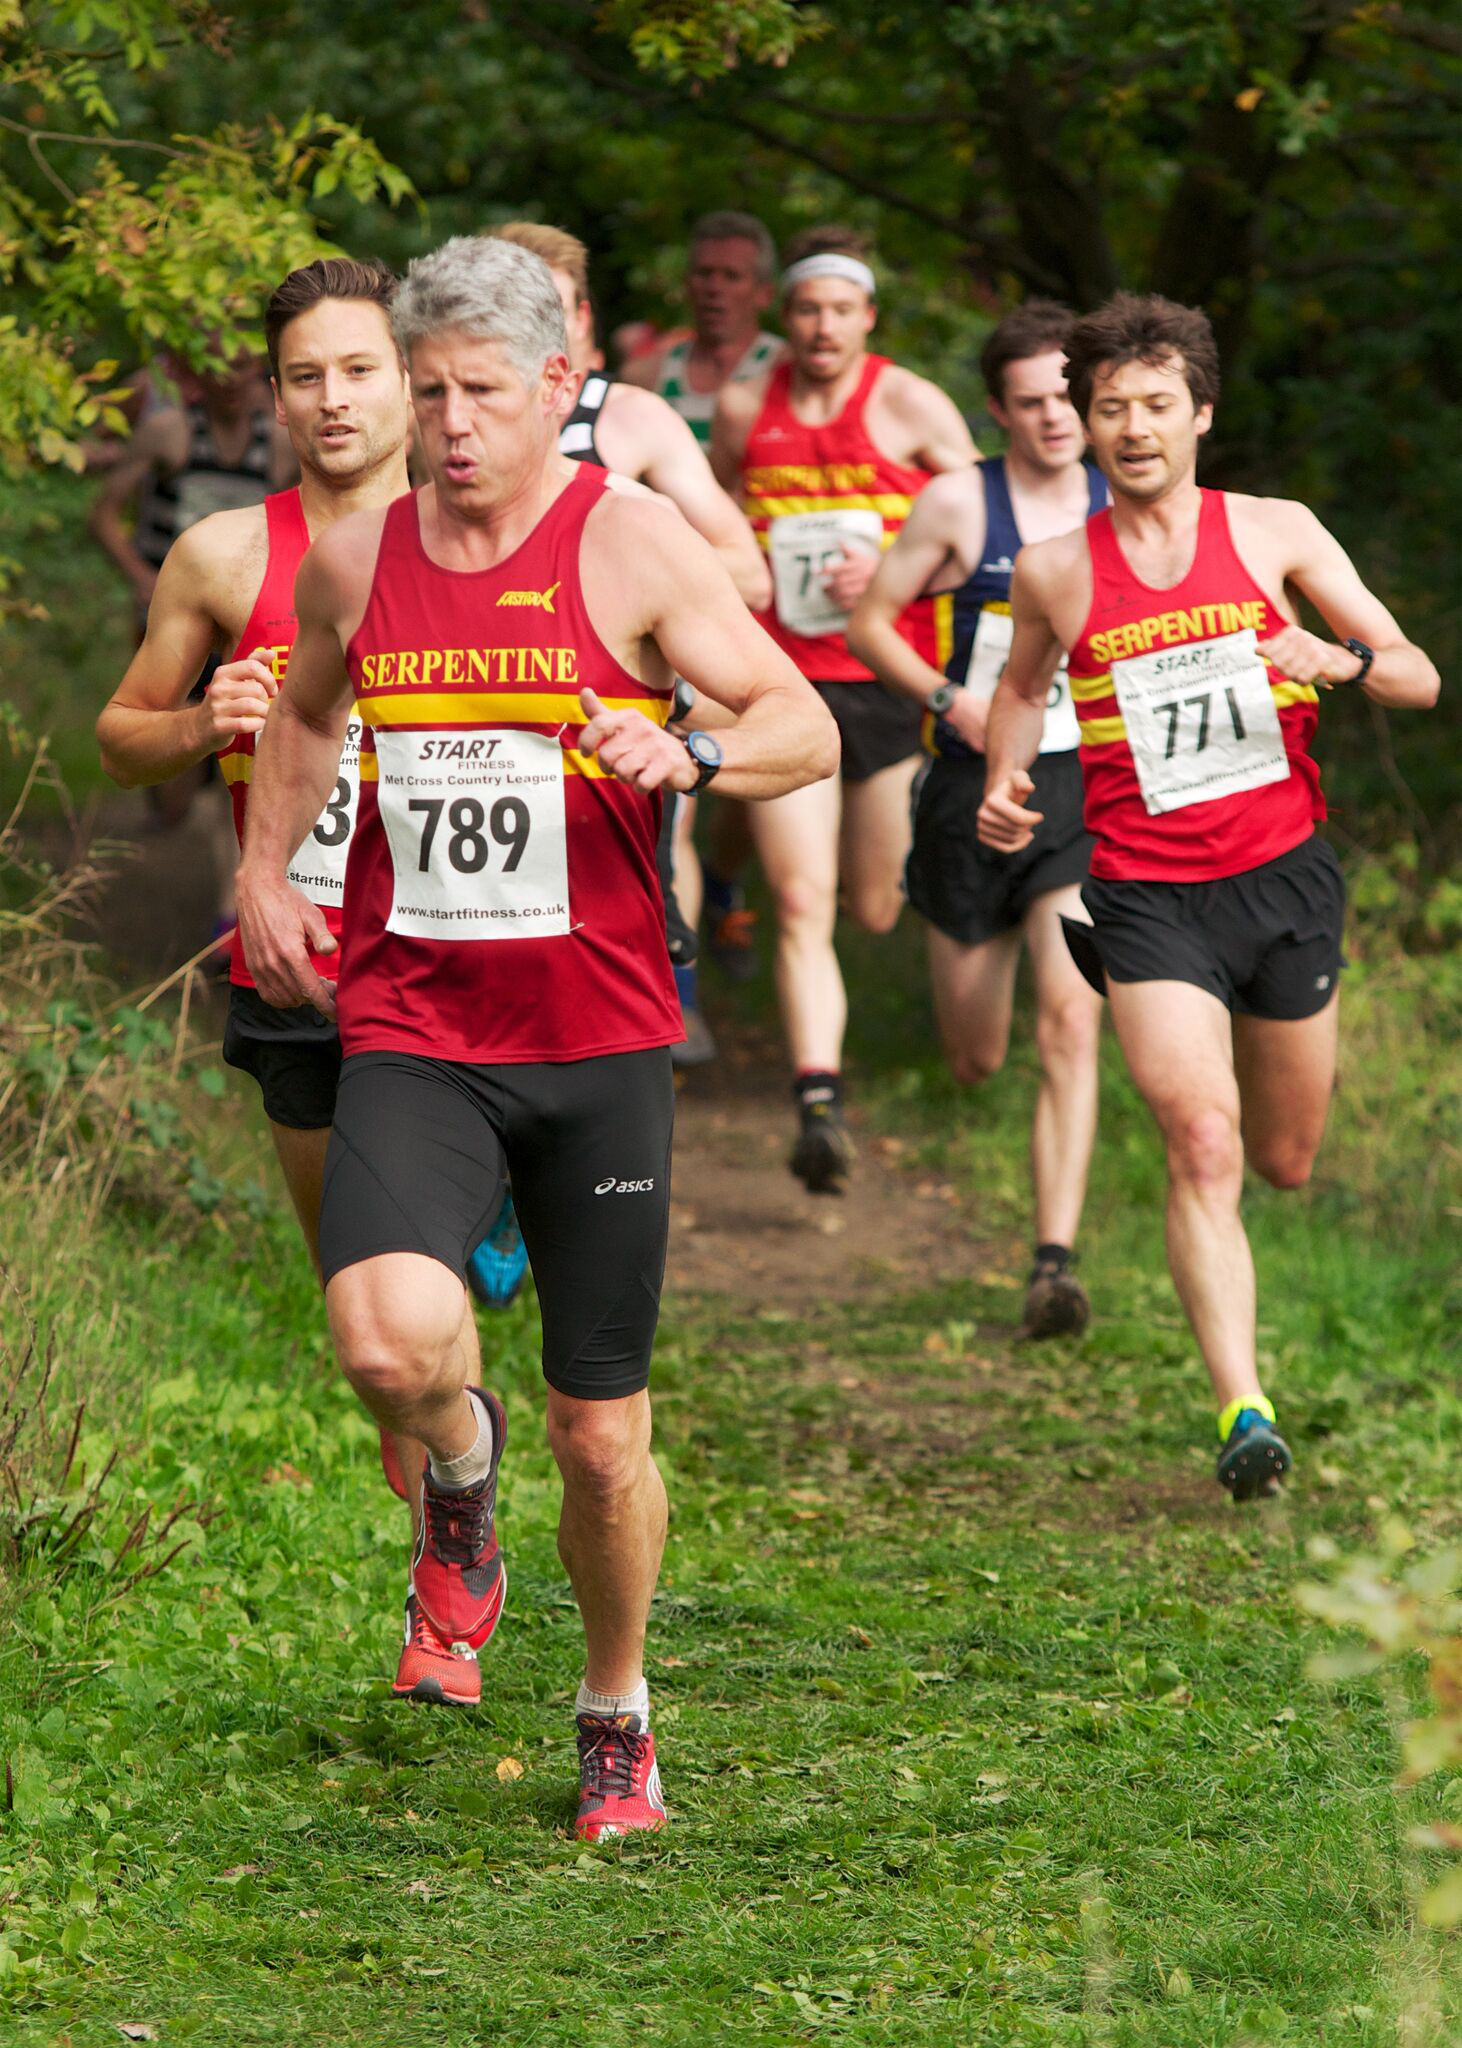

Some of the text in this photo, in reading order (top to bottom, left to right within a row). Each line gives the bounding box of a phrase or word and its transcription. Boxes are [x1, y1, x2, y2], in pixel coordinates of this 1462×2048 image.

[1089, 602, 1267, 664] SERPENTINE
[361, 648, 579, 689] SERPENTINE
[1153, 648, 1215, 675] START
[1153, 687, 1247, 760] 771
[418, 739, 501, 760] START
[458, 760, 515, 770] FITNESS
[385, 773, 557, 786] Met Cross Country League
[408, 796, 531, 874] 789
[396, 904, 565, 920] www.startfitness.co.uk
[615, 1178, 654, 1193] asics
